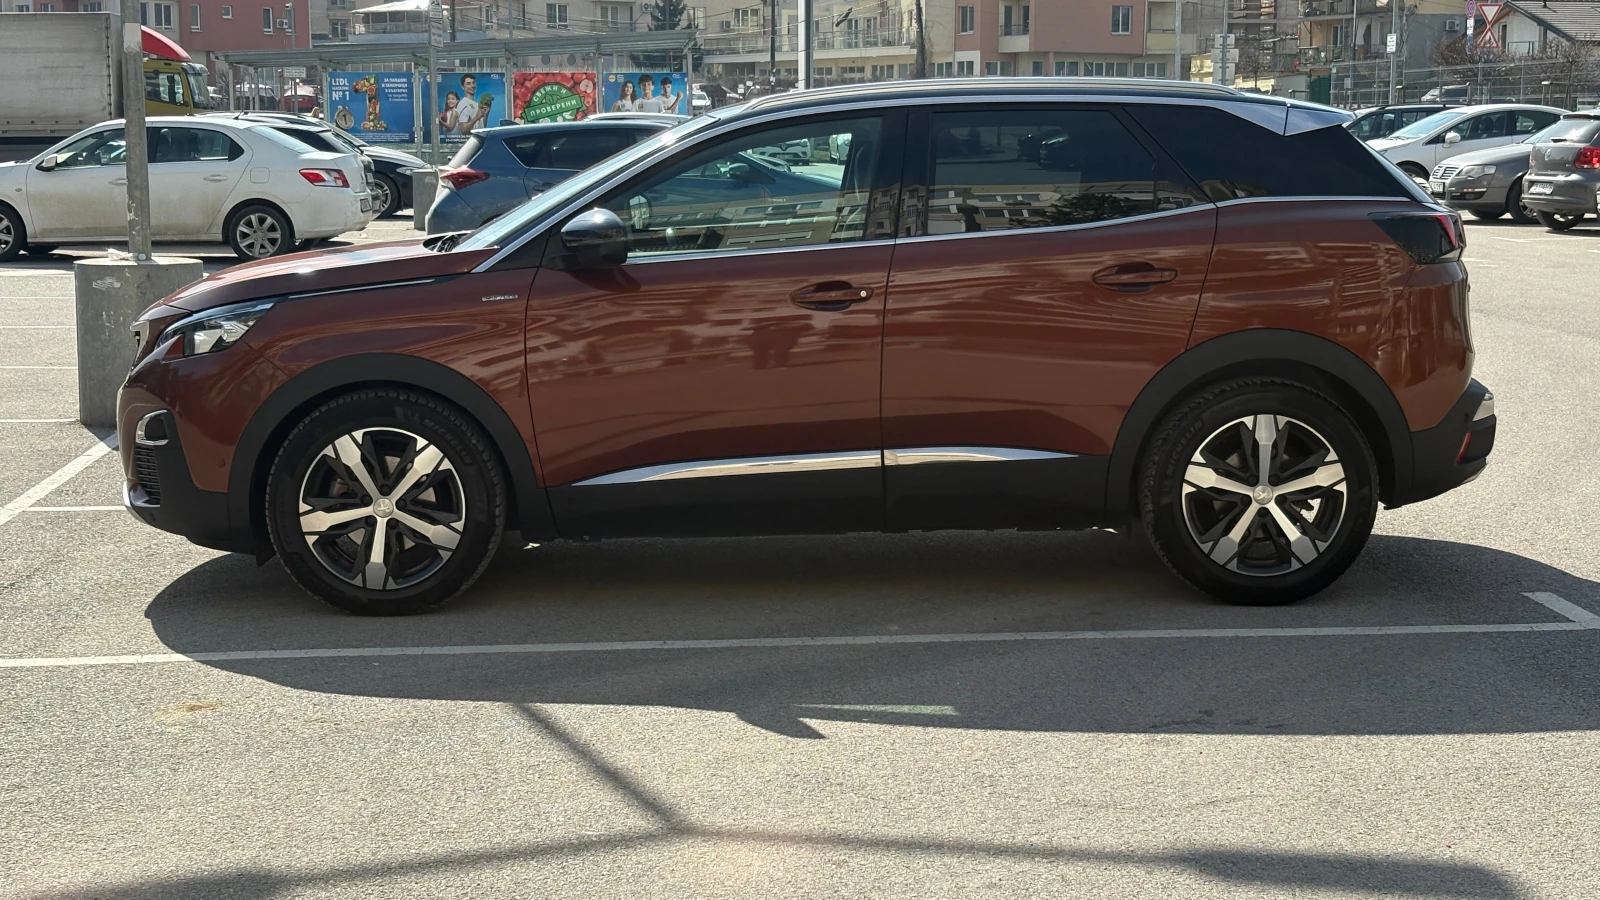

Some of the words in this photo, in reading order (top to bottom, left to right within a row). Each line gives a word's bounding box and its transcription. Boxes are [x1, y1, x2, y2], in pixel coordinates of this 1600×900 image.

[530, 99, 577, 117] ПРОВЕРЕНИ
[533, 85, 558, 101] СВЕЖИ
[422, 418, 473, 465] MICHELIN
[1165, 419, 1203, 476] MICHELIN
